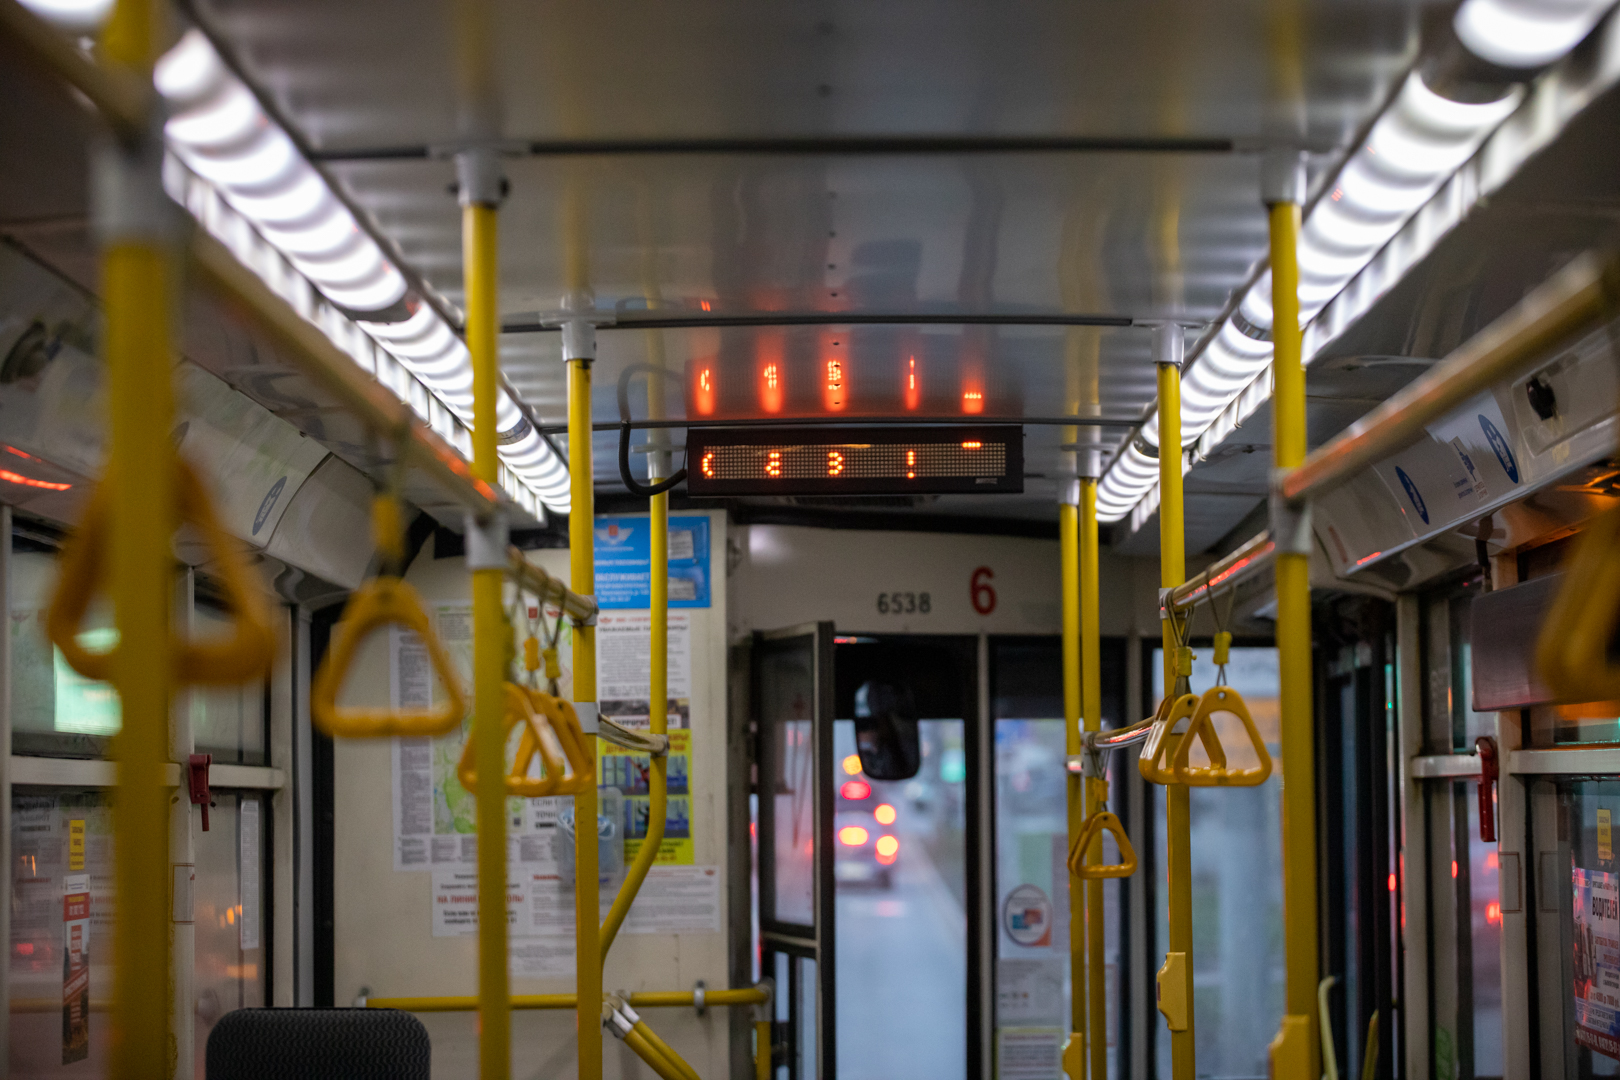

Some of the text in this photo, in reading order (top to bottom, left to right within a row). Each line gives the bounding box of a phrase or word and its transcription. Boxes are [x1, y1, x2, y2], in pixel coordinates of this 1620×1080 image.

[969, 565, 997, 616] 6
[877, 592, 931, 614] 6538
[1592, 896, 1618, 920] ВОДИТЕЛЕЙ
